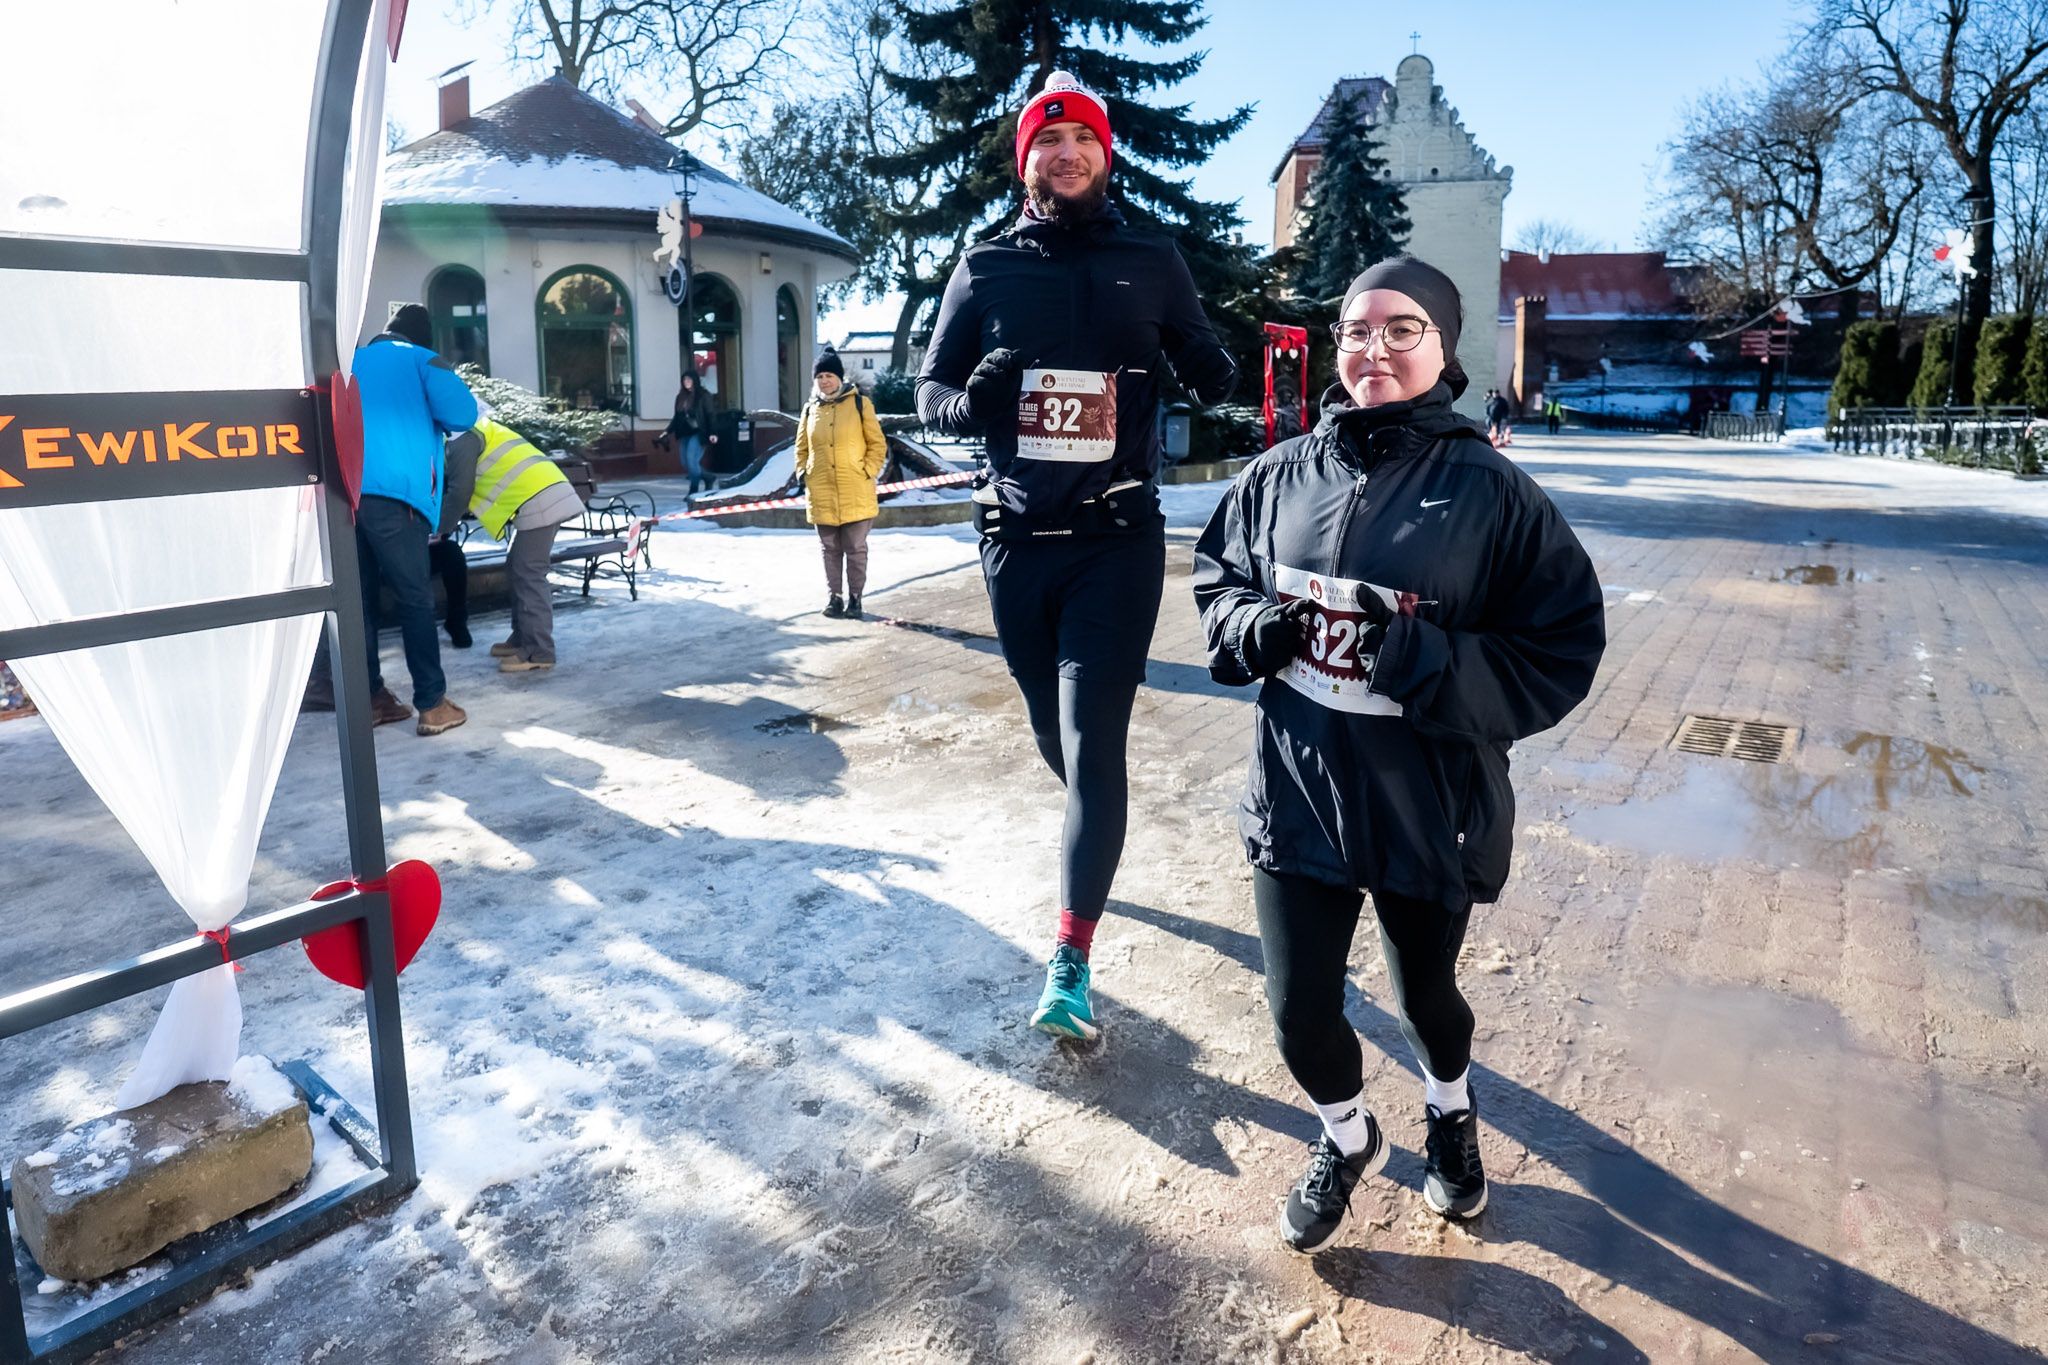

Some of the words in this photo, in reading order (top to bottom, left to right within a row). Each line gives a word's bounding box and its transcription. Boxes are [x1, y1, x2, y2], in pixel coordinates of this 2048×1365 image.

[1043, 397, 1082, 433] 32
[0, 415, 305, 488] EWIKOR
[1310, 613, 1357, 669] 32
